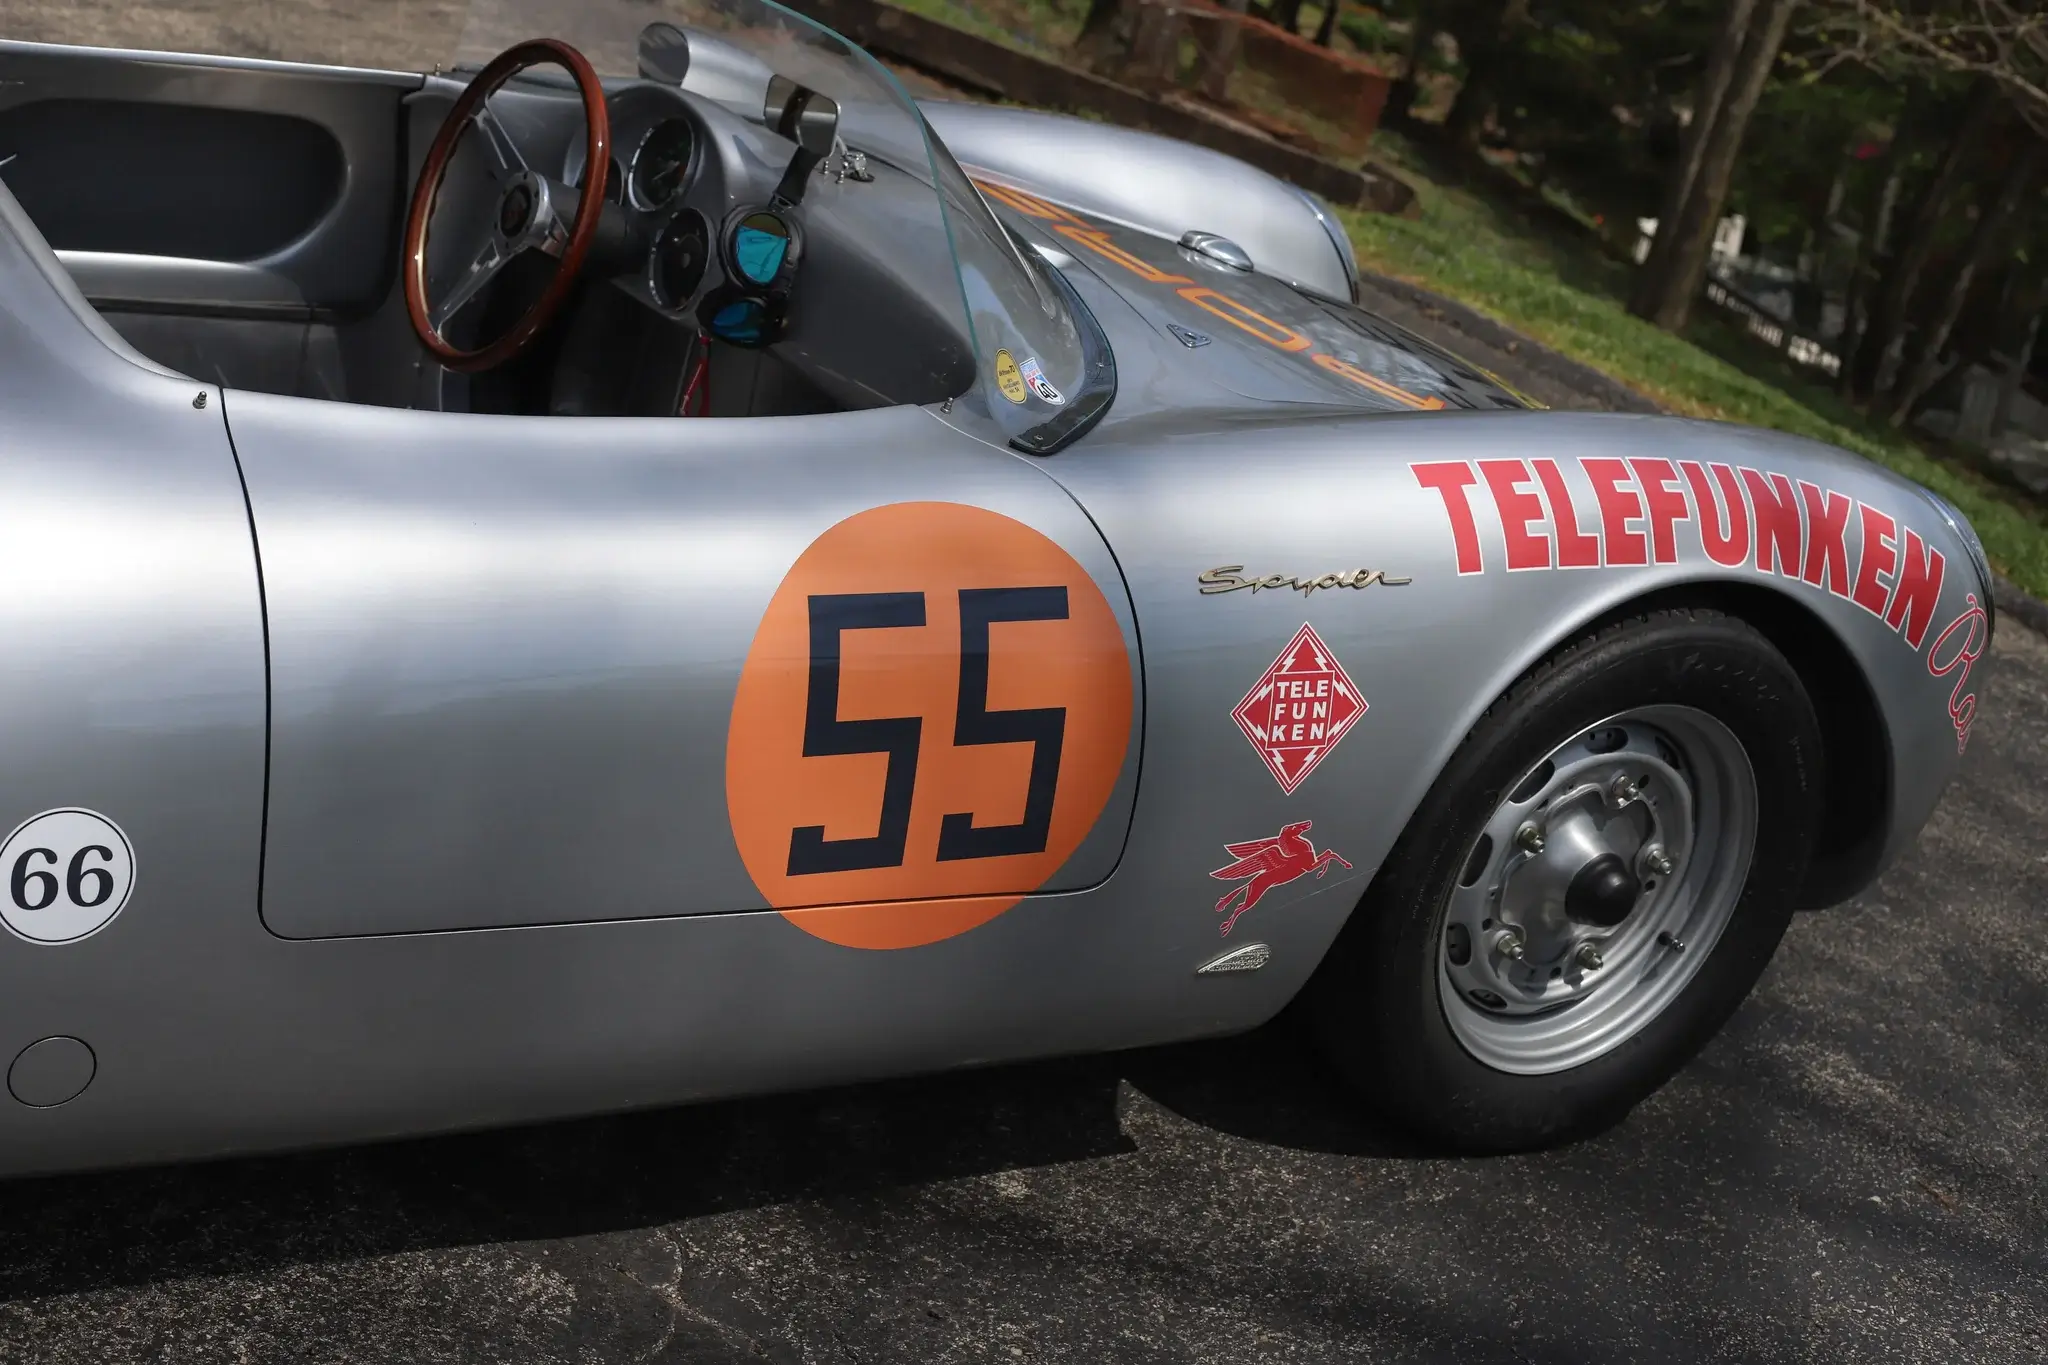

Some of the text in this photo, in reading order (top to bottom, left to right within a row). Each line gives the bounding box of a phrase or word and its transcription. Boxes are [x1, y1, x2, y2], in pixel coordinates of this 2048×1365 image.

[1407, 456, 1946, 652] TELEFUNKEN
[1199, 565, 1413, 598] Spyder
[1276, 679, 1329, 699] TELE
[1273, 702, 1327, 722] FUN
[786, 585, 1070, 877] 55
[1271, 722, 1325, 742] KEN
[10, 845, 114, 911] 66
